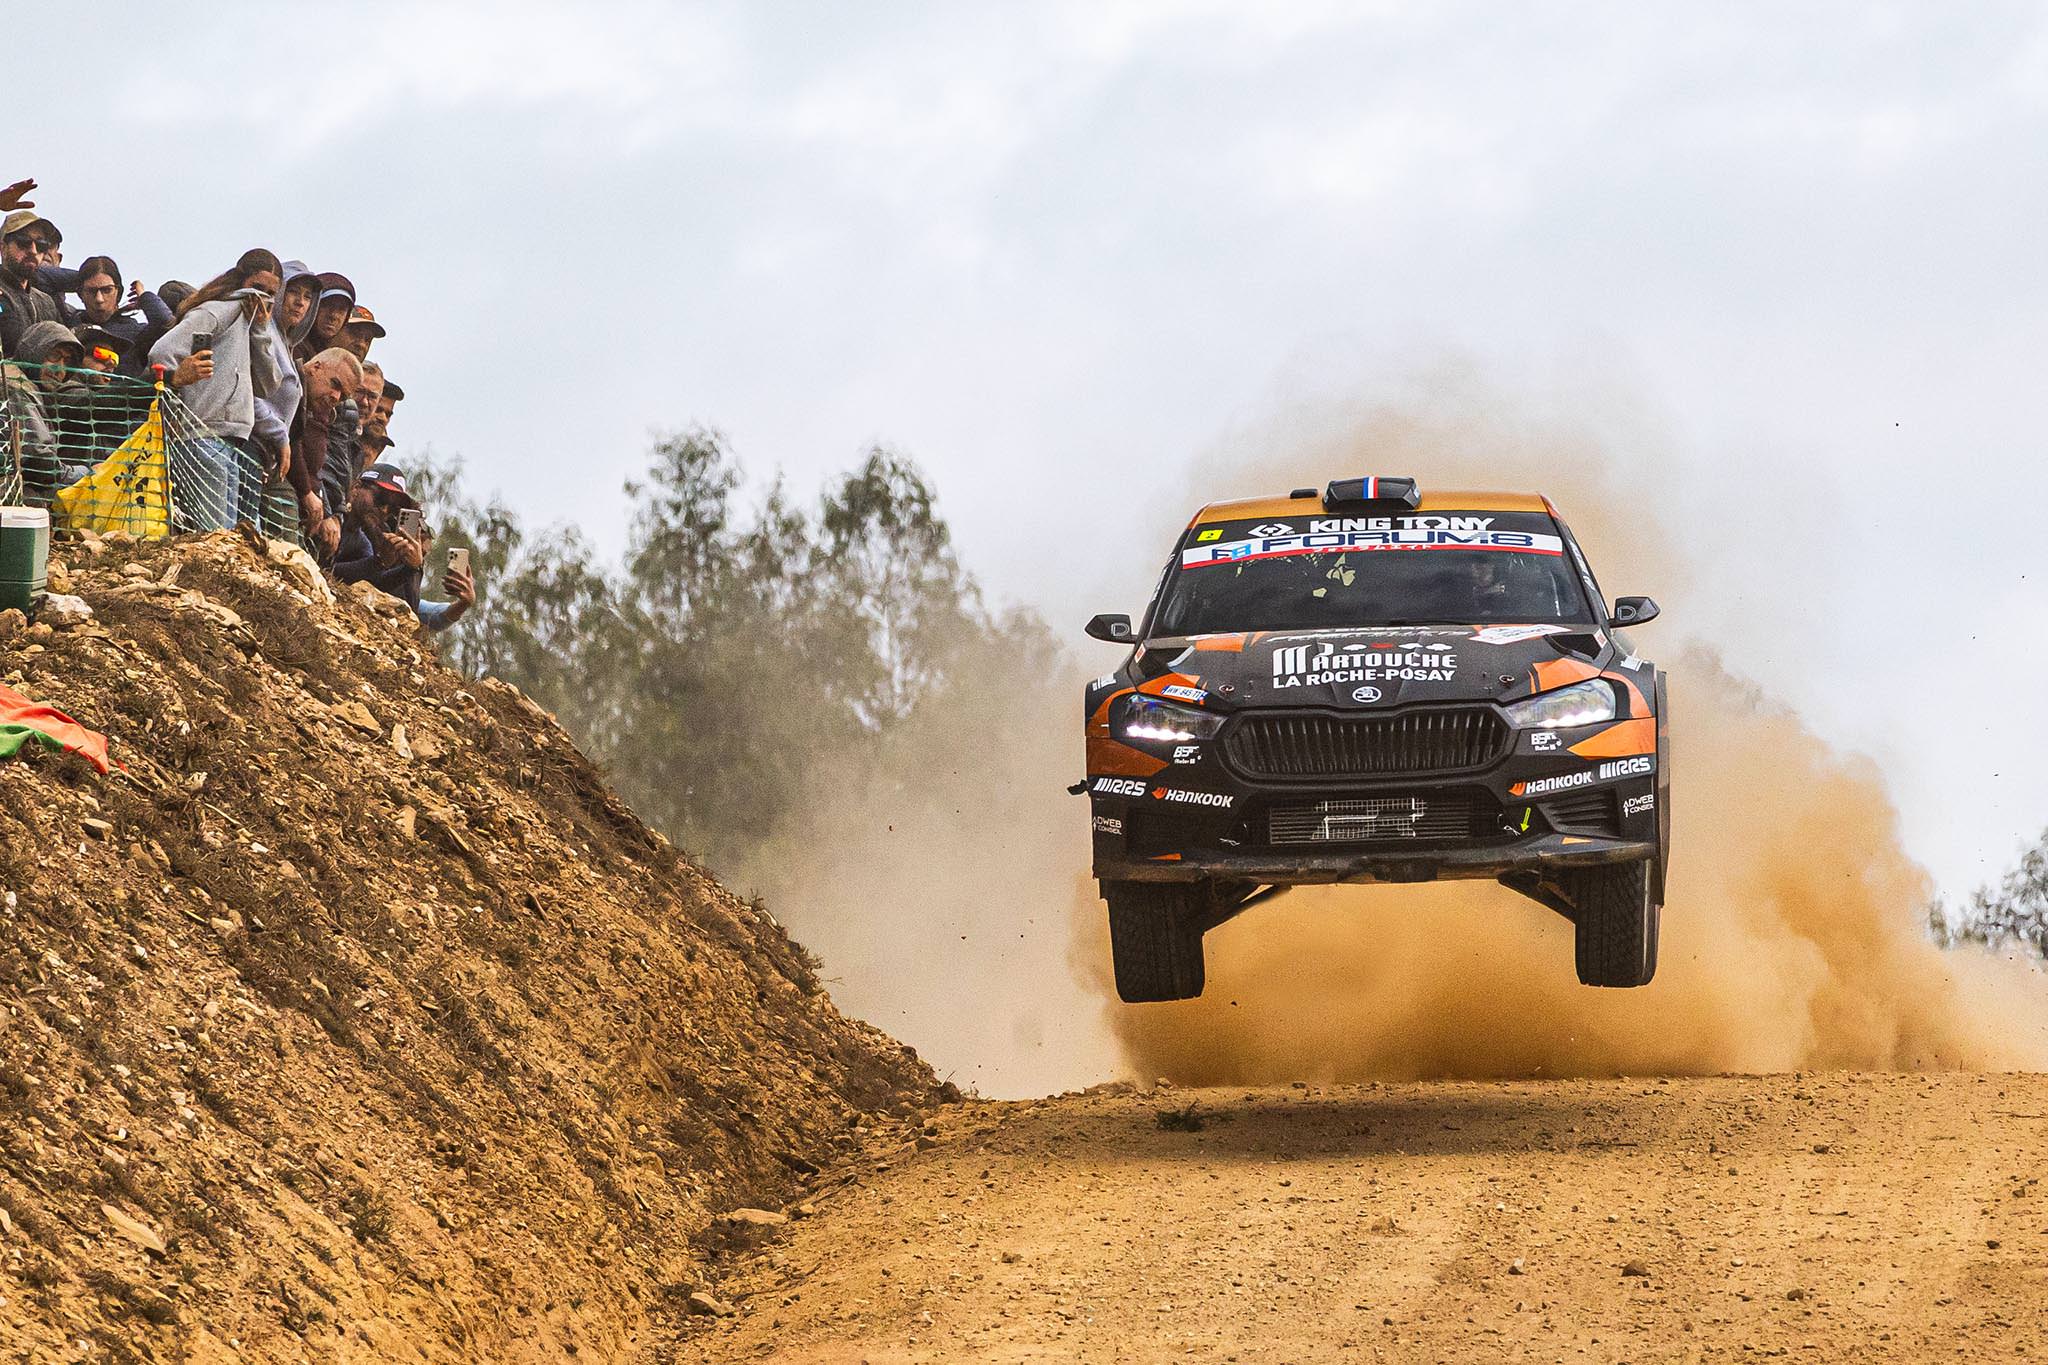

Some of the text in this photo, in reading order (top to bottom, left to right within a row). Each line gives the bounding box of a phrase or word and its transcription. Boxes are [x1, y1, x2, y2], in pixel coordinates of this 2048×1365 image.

[1310, 518, 1391, 533] KING
[1397, 517, 1495, 530] TONY
[1262, 531, 1533, 552] FORUM8
[1273, 667, 1455, 689] LA ROCHE-POSAY
